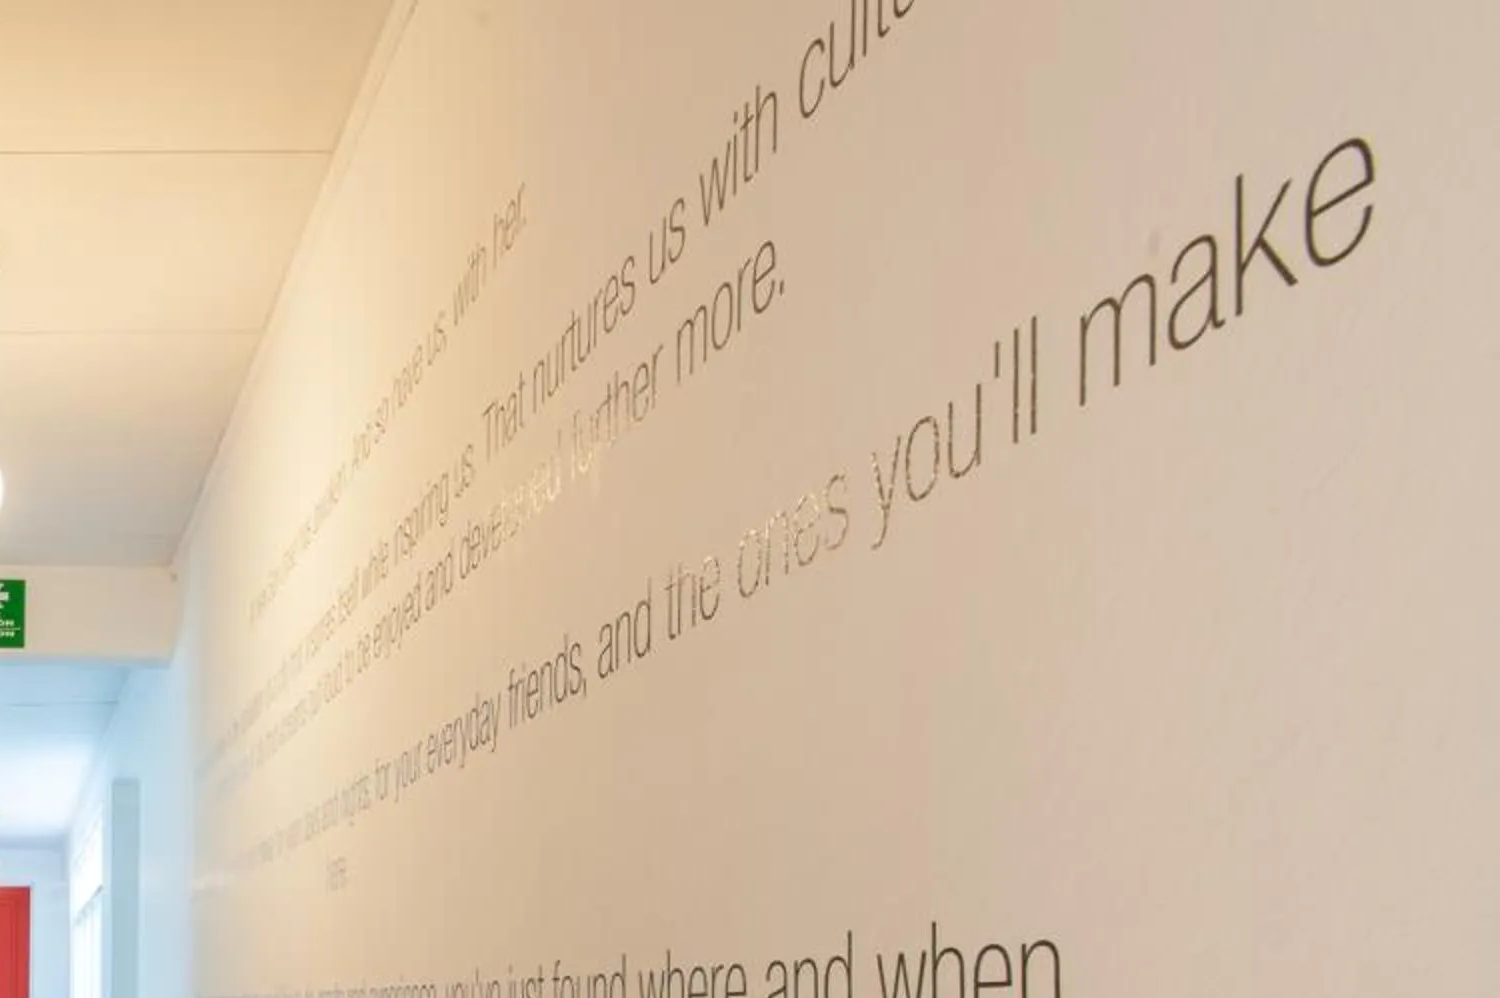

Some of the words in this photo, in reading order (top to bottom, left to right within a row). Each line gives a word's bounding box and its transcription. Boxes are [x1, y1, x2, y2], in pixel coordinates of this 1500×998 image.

[426, 552, 453, 611] and
[572, 344, 663, 477] further
[677, 241, 784, 381] more.
[454, 243, 486, 326] with
[494, 182, 526, 267] her.
[482, 372, 525, 458] That
[534, 256, 635, 412] nurtures
[650, 198, 685, 284] us
[700, 86, 777, 226] with
[395, 740, 423, 803] your
[427, 690, 500, 774] everyday
[507, 630, 587, 728] friends,
[598, 595, 651, 679] and
[665, 560, 720, 640] the
[737, 474, 849, 598] ones
[873, 316, 1037, 549] you'll
[1080, 138, 1374, 406] make
